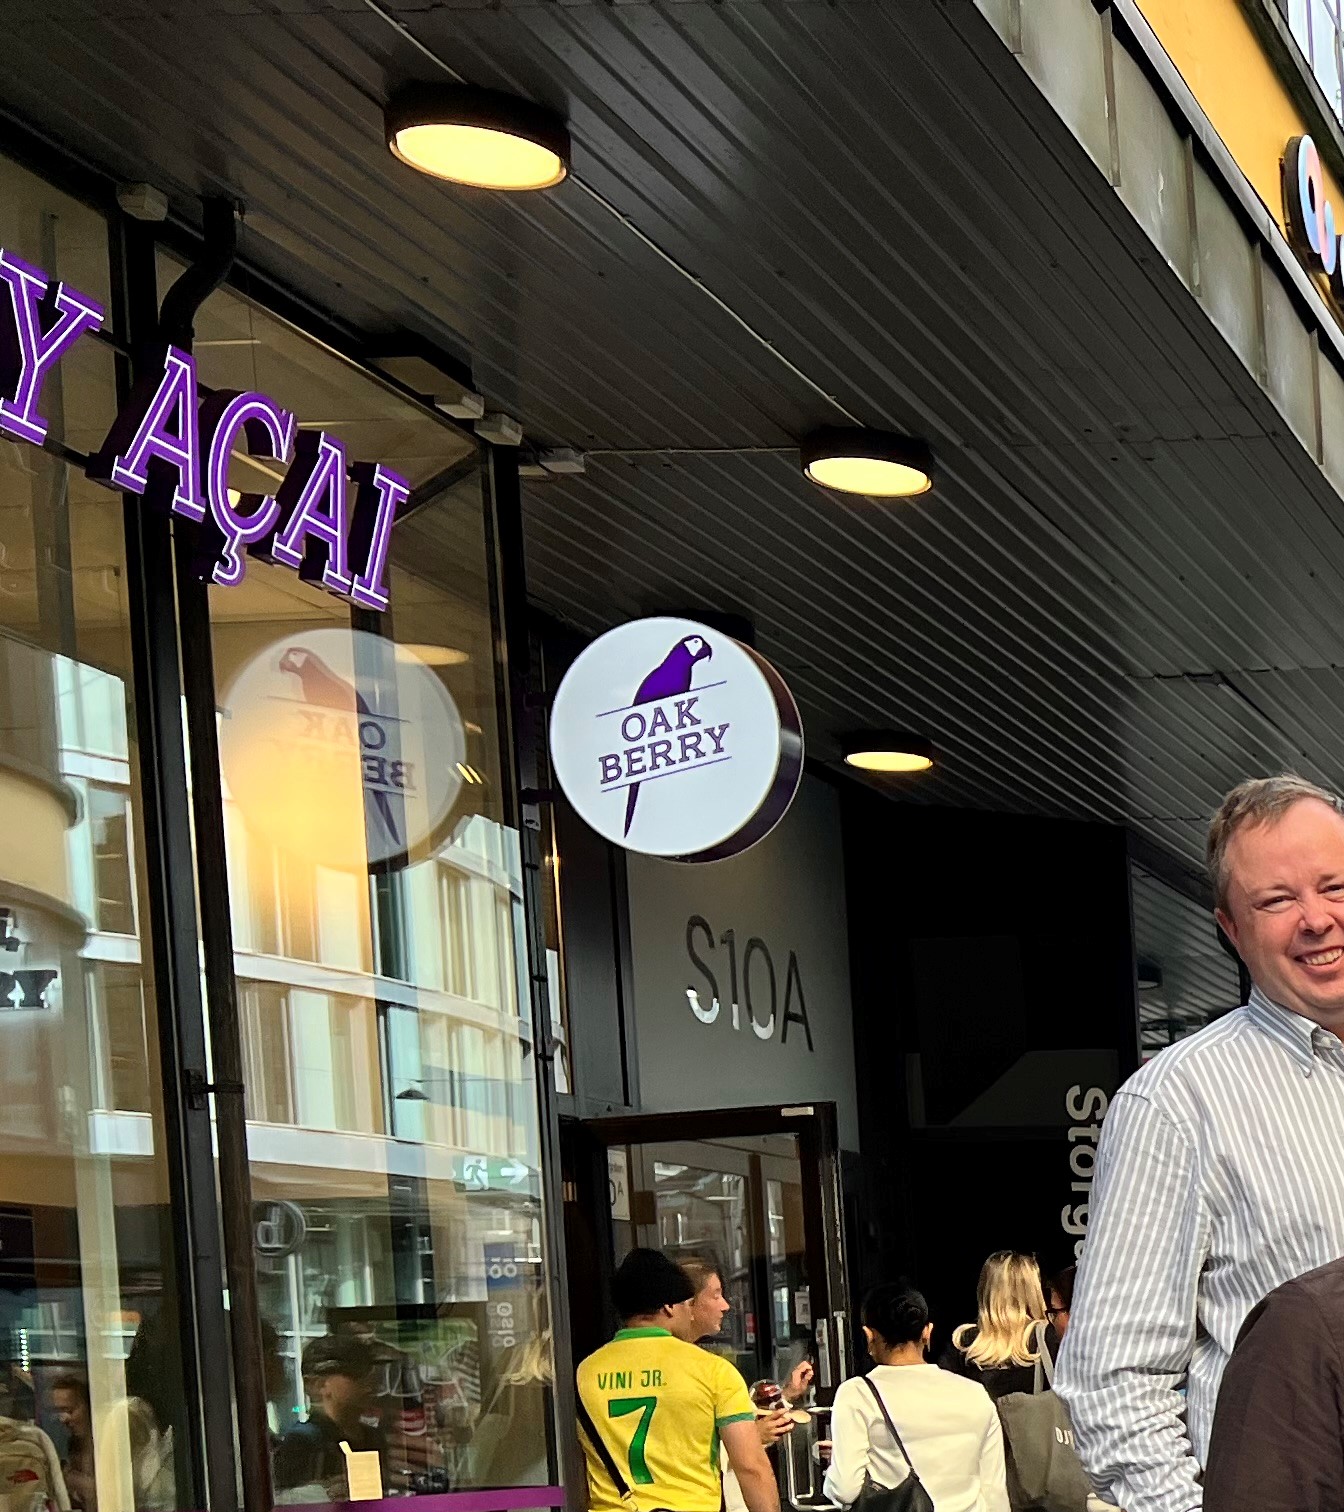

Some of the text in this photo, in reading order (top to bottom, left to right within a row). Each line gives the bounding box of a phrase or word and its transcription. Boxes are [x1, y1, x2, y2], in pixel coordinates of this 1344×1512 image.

[111, 345, 410, 612] AÇAI
[598, 722, 731, 785] BERRY
[621, 697, 702, 742] OAK
[686, 914, 815, 1053] S10A
[598, 1369, 668, 1390] VINI JR.
[608, 1396, 658, 1485] 7
